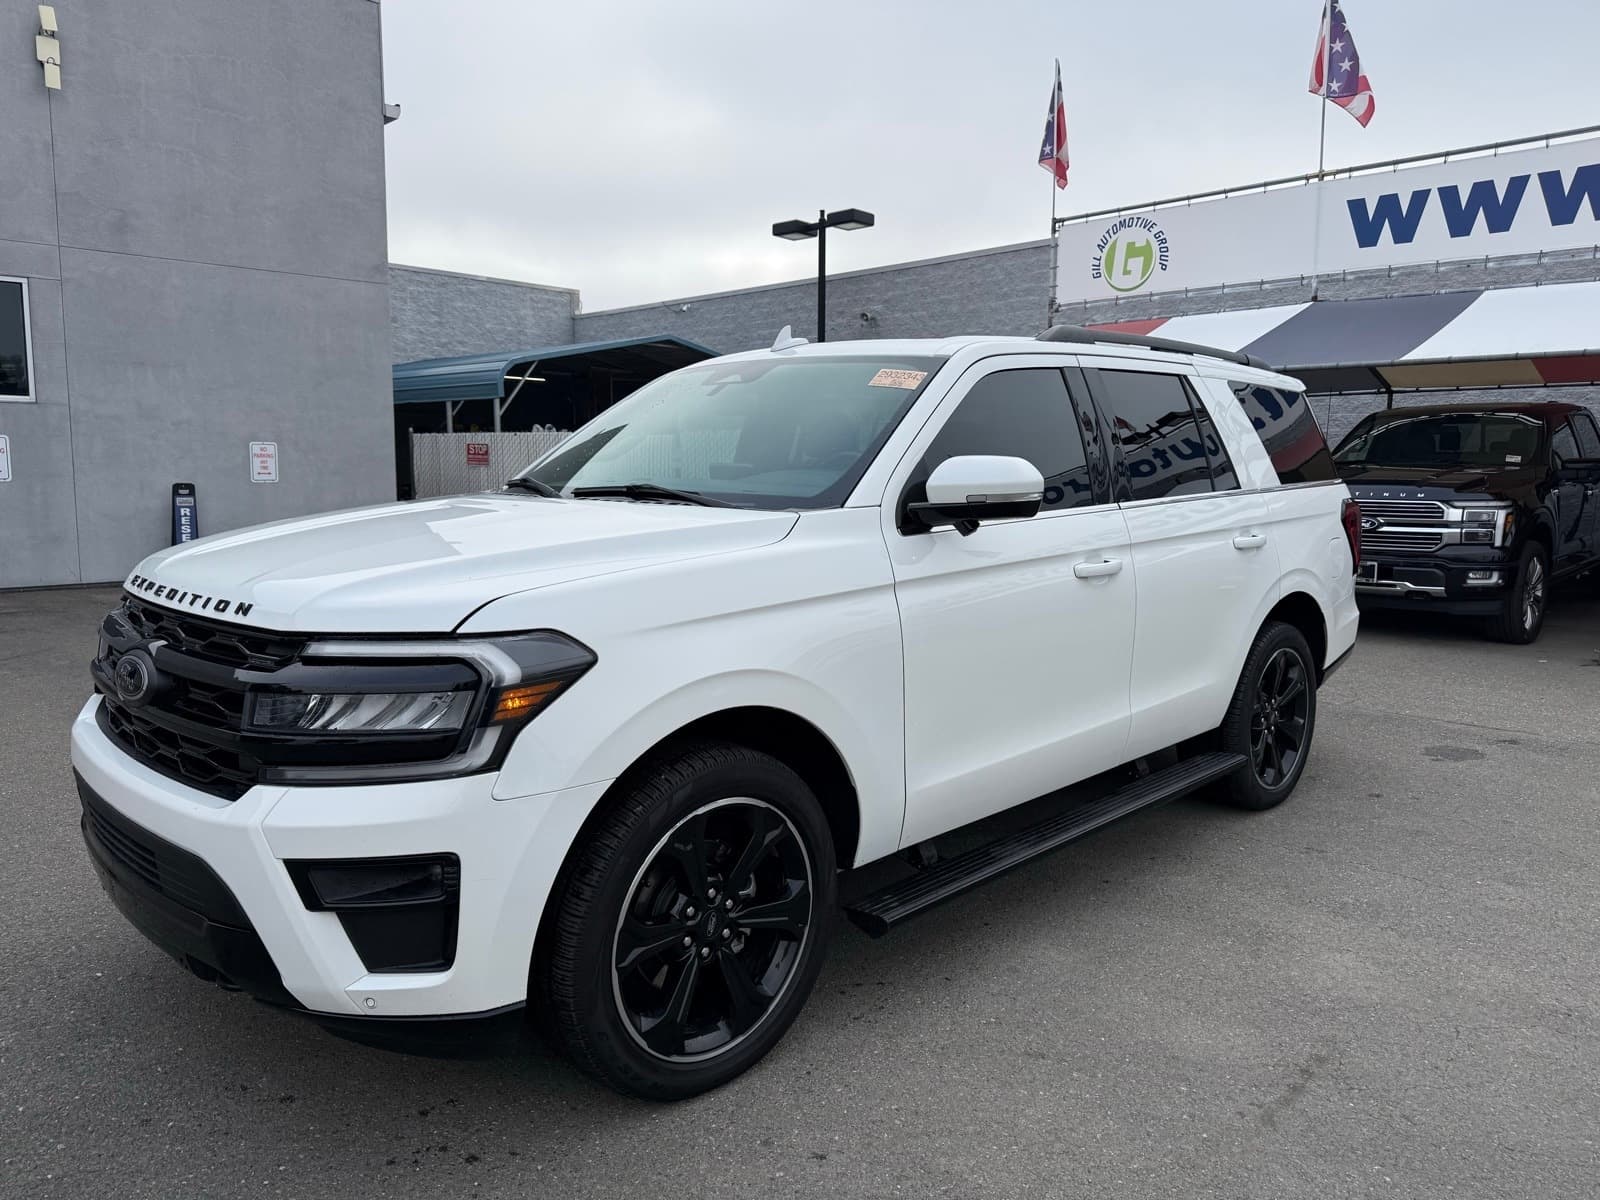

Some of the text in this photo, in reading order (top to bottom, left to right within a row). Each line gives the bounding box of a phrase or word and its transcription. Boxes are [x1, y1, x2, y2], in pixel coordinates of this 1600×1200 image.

[1091, 216, 1169, 279] GILL AUTOMOTIVE GROUP
[468, 444, 488, 454] STOP
[130, 574, 254, 617] EXPEDITION
